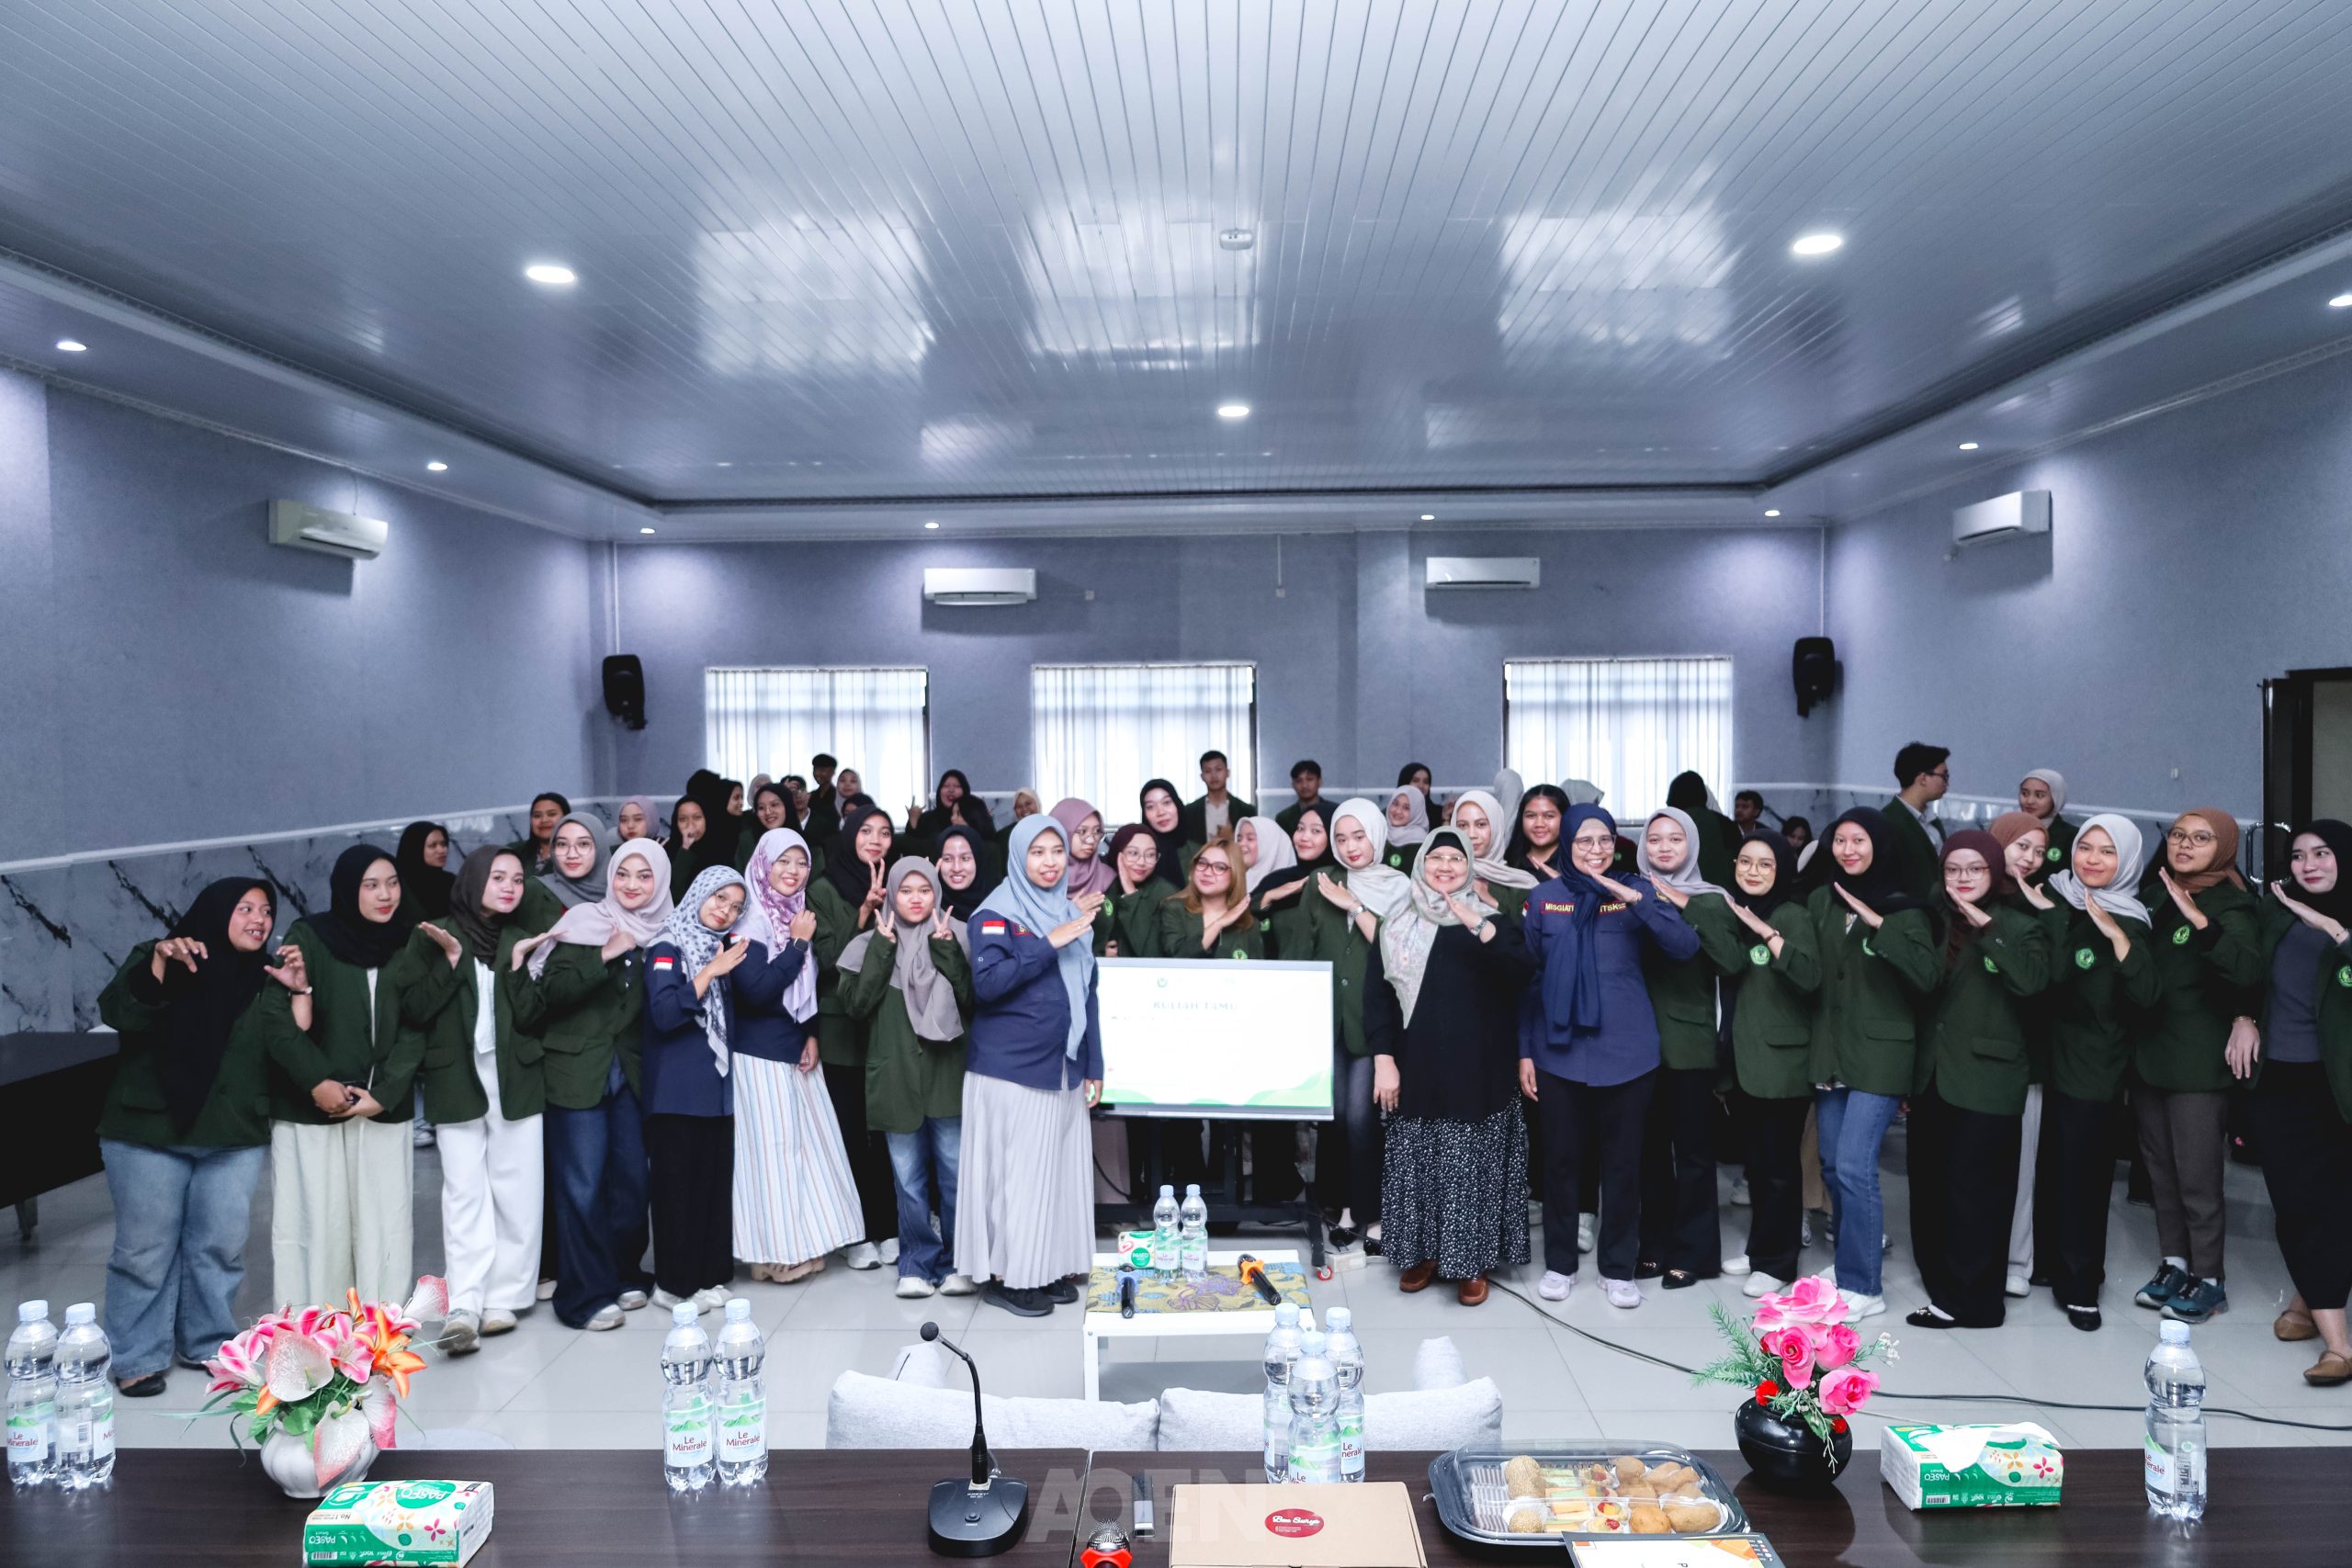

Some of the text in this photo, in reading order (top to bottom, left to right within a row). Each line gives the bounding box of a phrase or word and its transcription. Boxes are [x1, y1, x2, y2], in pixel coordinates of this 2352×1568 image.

[1545, 903, 1574, 912] MISGIATI
[13, 1432, 23, 1440] Le
[738, 1430, 749, 1439] Le
[673, 1439, 707, 1451] Minerale
[684, 1436, 695, 1445] Le
[726, 1435, 761, 1447] Minerale
[1342, 1442, 1353, 1450] Le
[1341, 1447, 1363, 1458] nerale
[1296, 1472, 1306, 1482] Le
[1924, 1472, 1951, 1481] PASEO
[309, 1535, 336, 1544] PASEO
